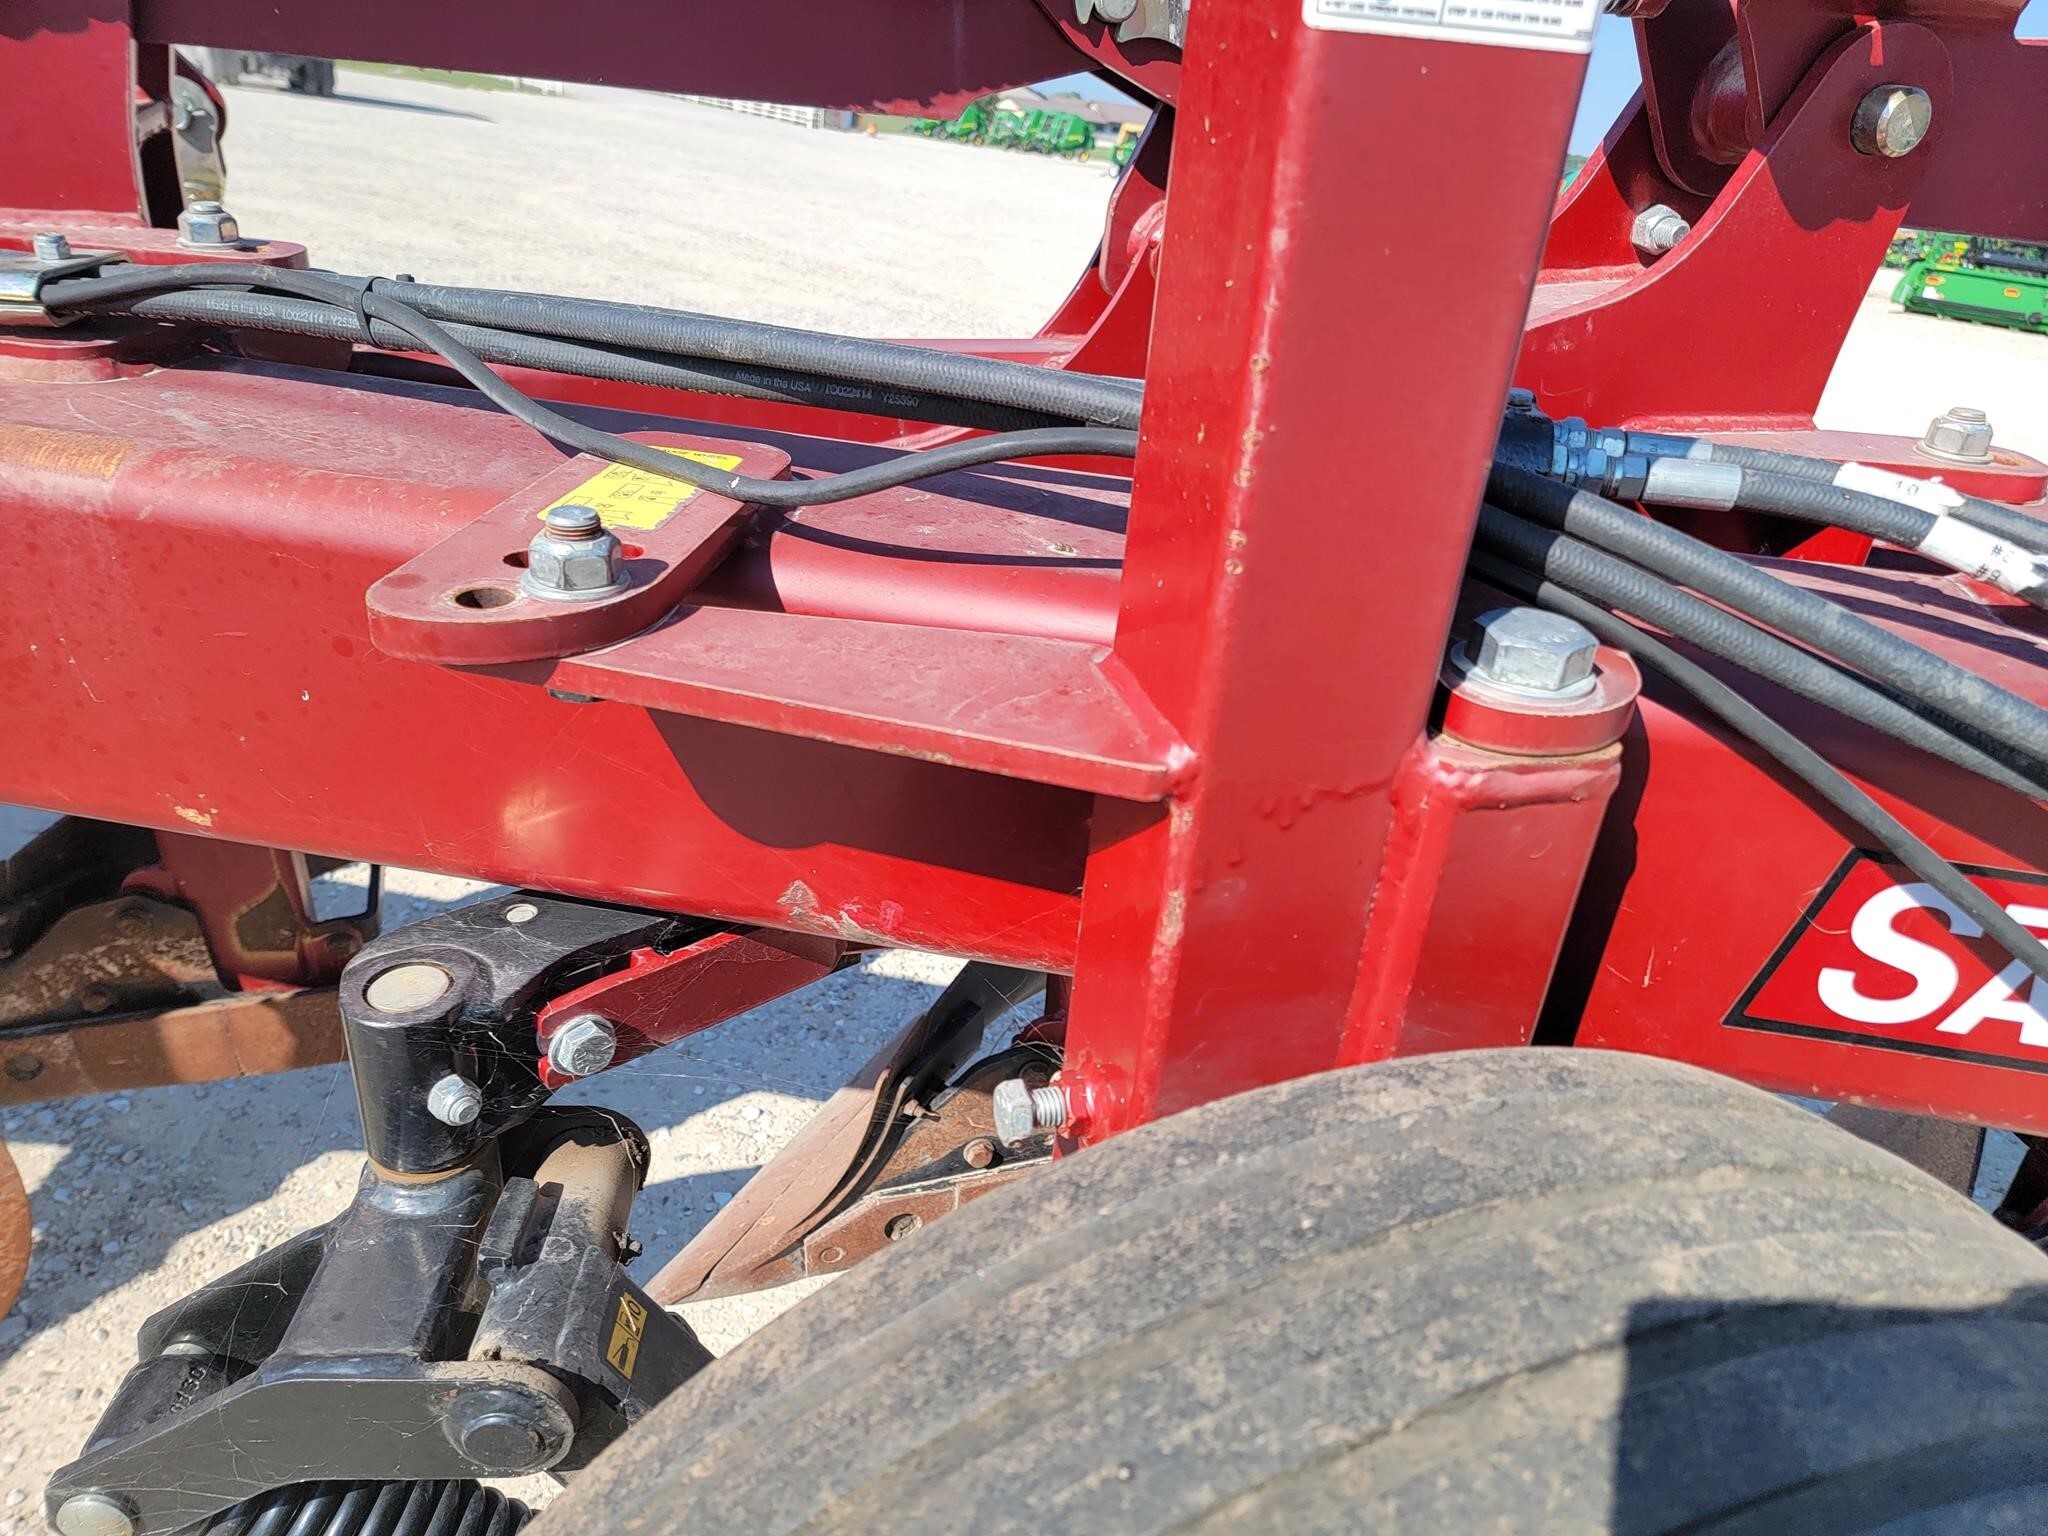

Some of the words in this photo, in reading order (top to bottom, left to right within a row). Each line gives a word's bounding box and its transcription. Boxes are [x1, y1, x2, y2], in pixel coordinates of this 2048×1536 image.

[255, 305, 276, 318] USA
[735, 370, 761, 385] Made
[763, 374, 772, 386] in
[773, 376, 788, 389] the
[790, 380, 812, 393] USA
